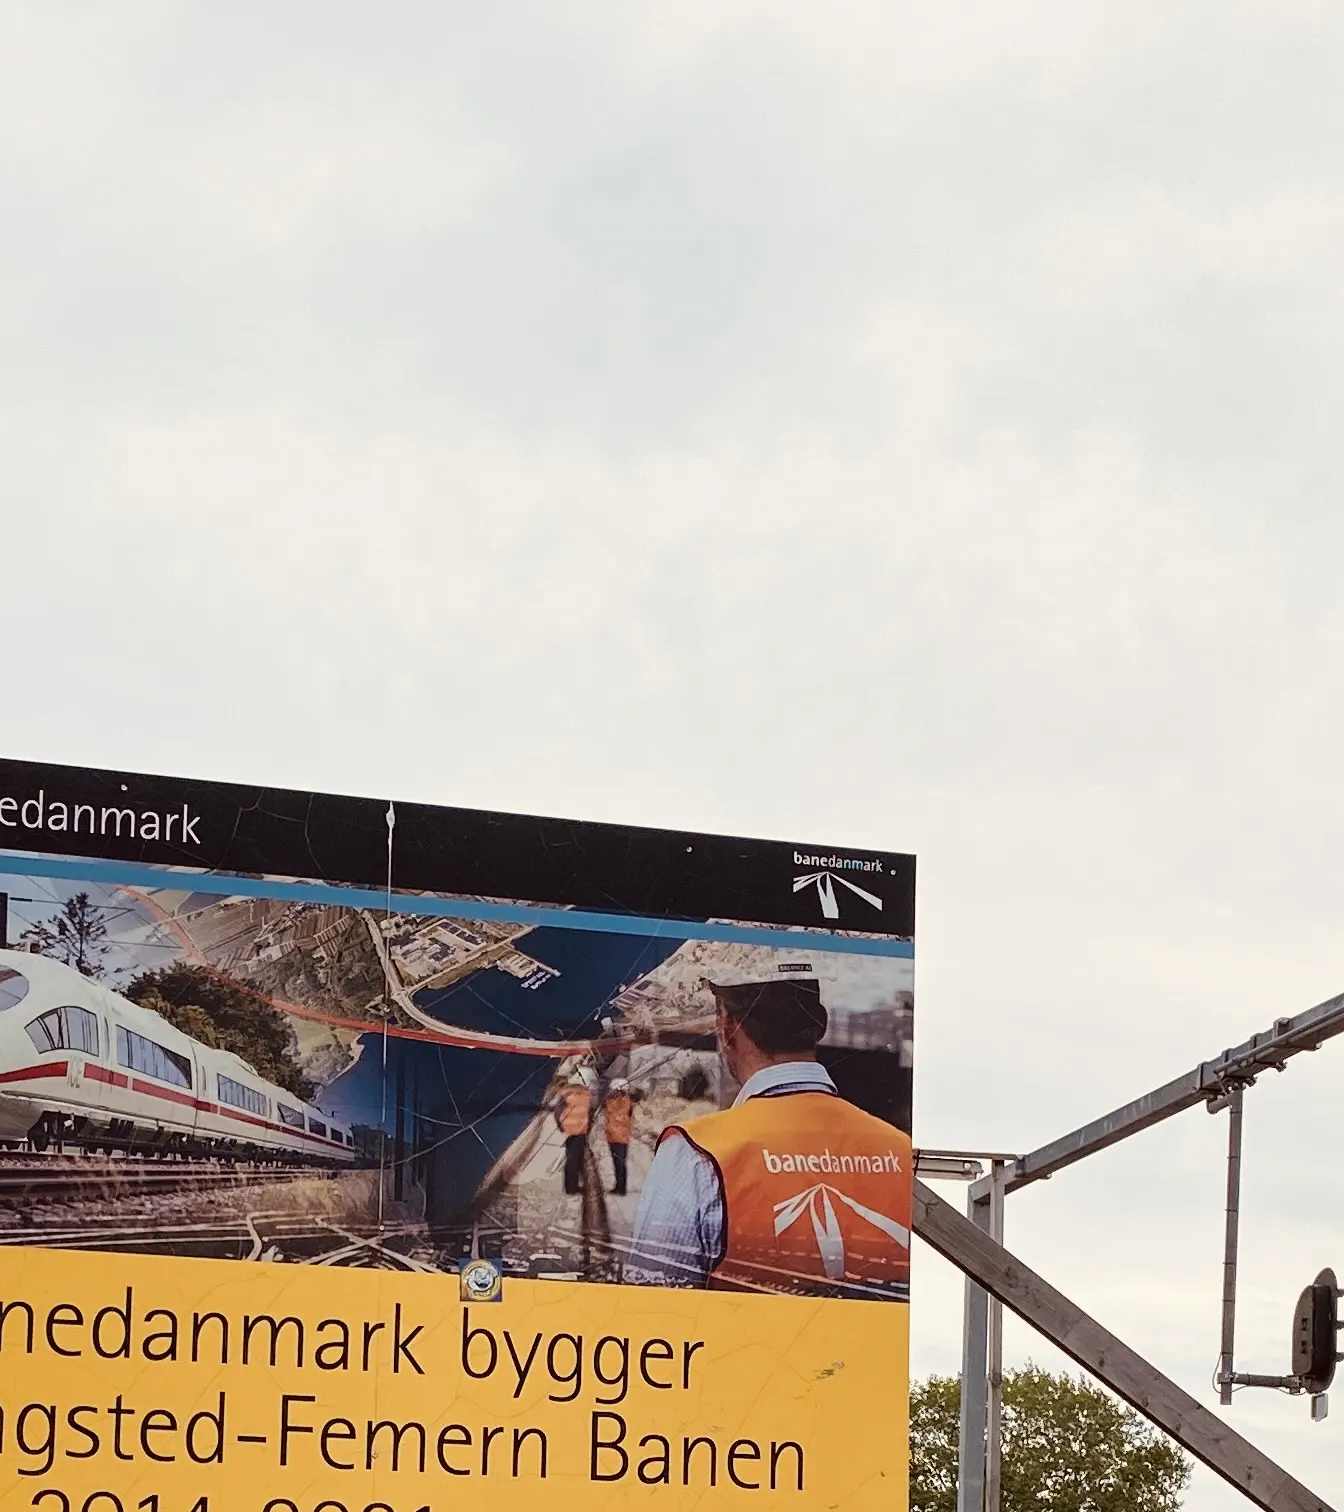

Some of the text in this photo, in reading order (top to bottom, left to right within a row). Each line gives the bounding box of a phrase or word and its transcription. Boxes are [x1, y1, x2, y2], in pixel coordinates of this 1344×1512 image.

[793, 850, 884, 873] banedanmark
[762, 1148, 903, 1174] banedanmark
[461, 1306, 705, 1405] bygger
[590, 1411, 804, 1491] Banen
